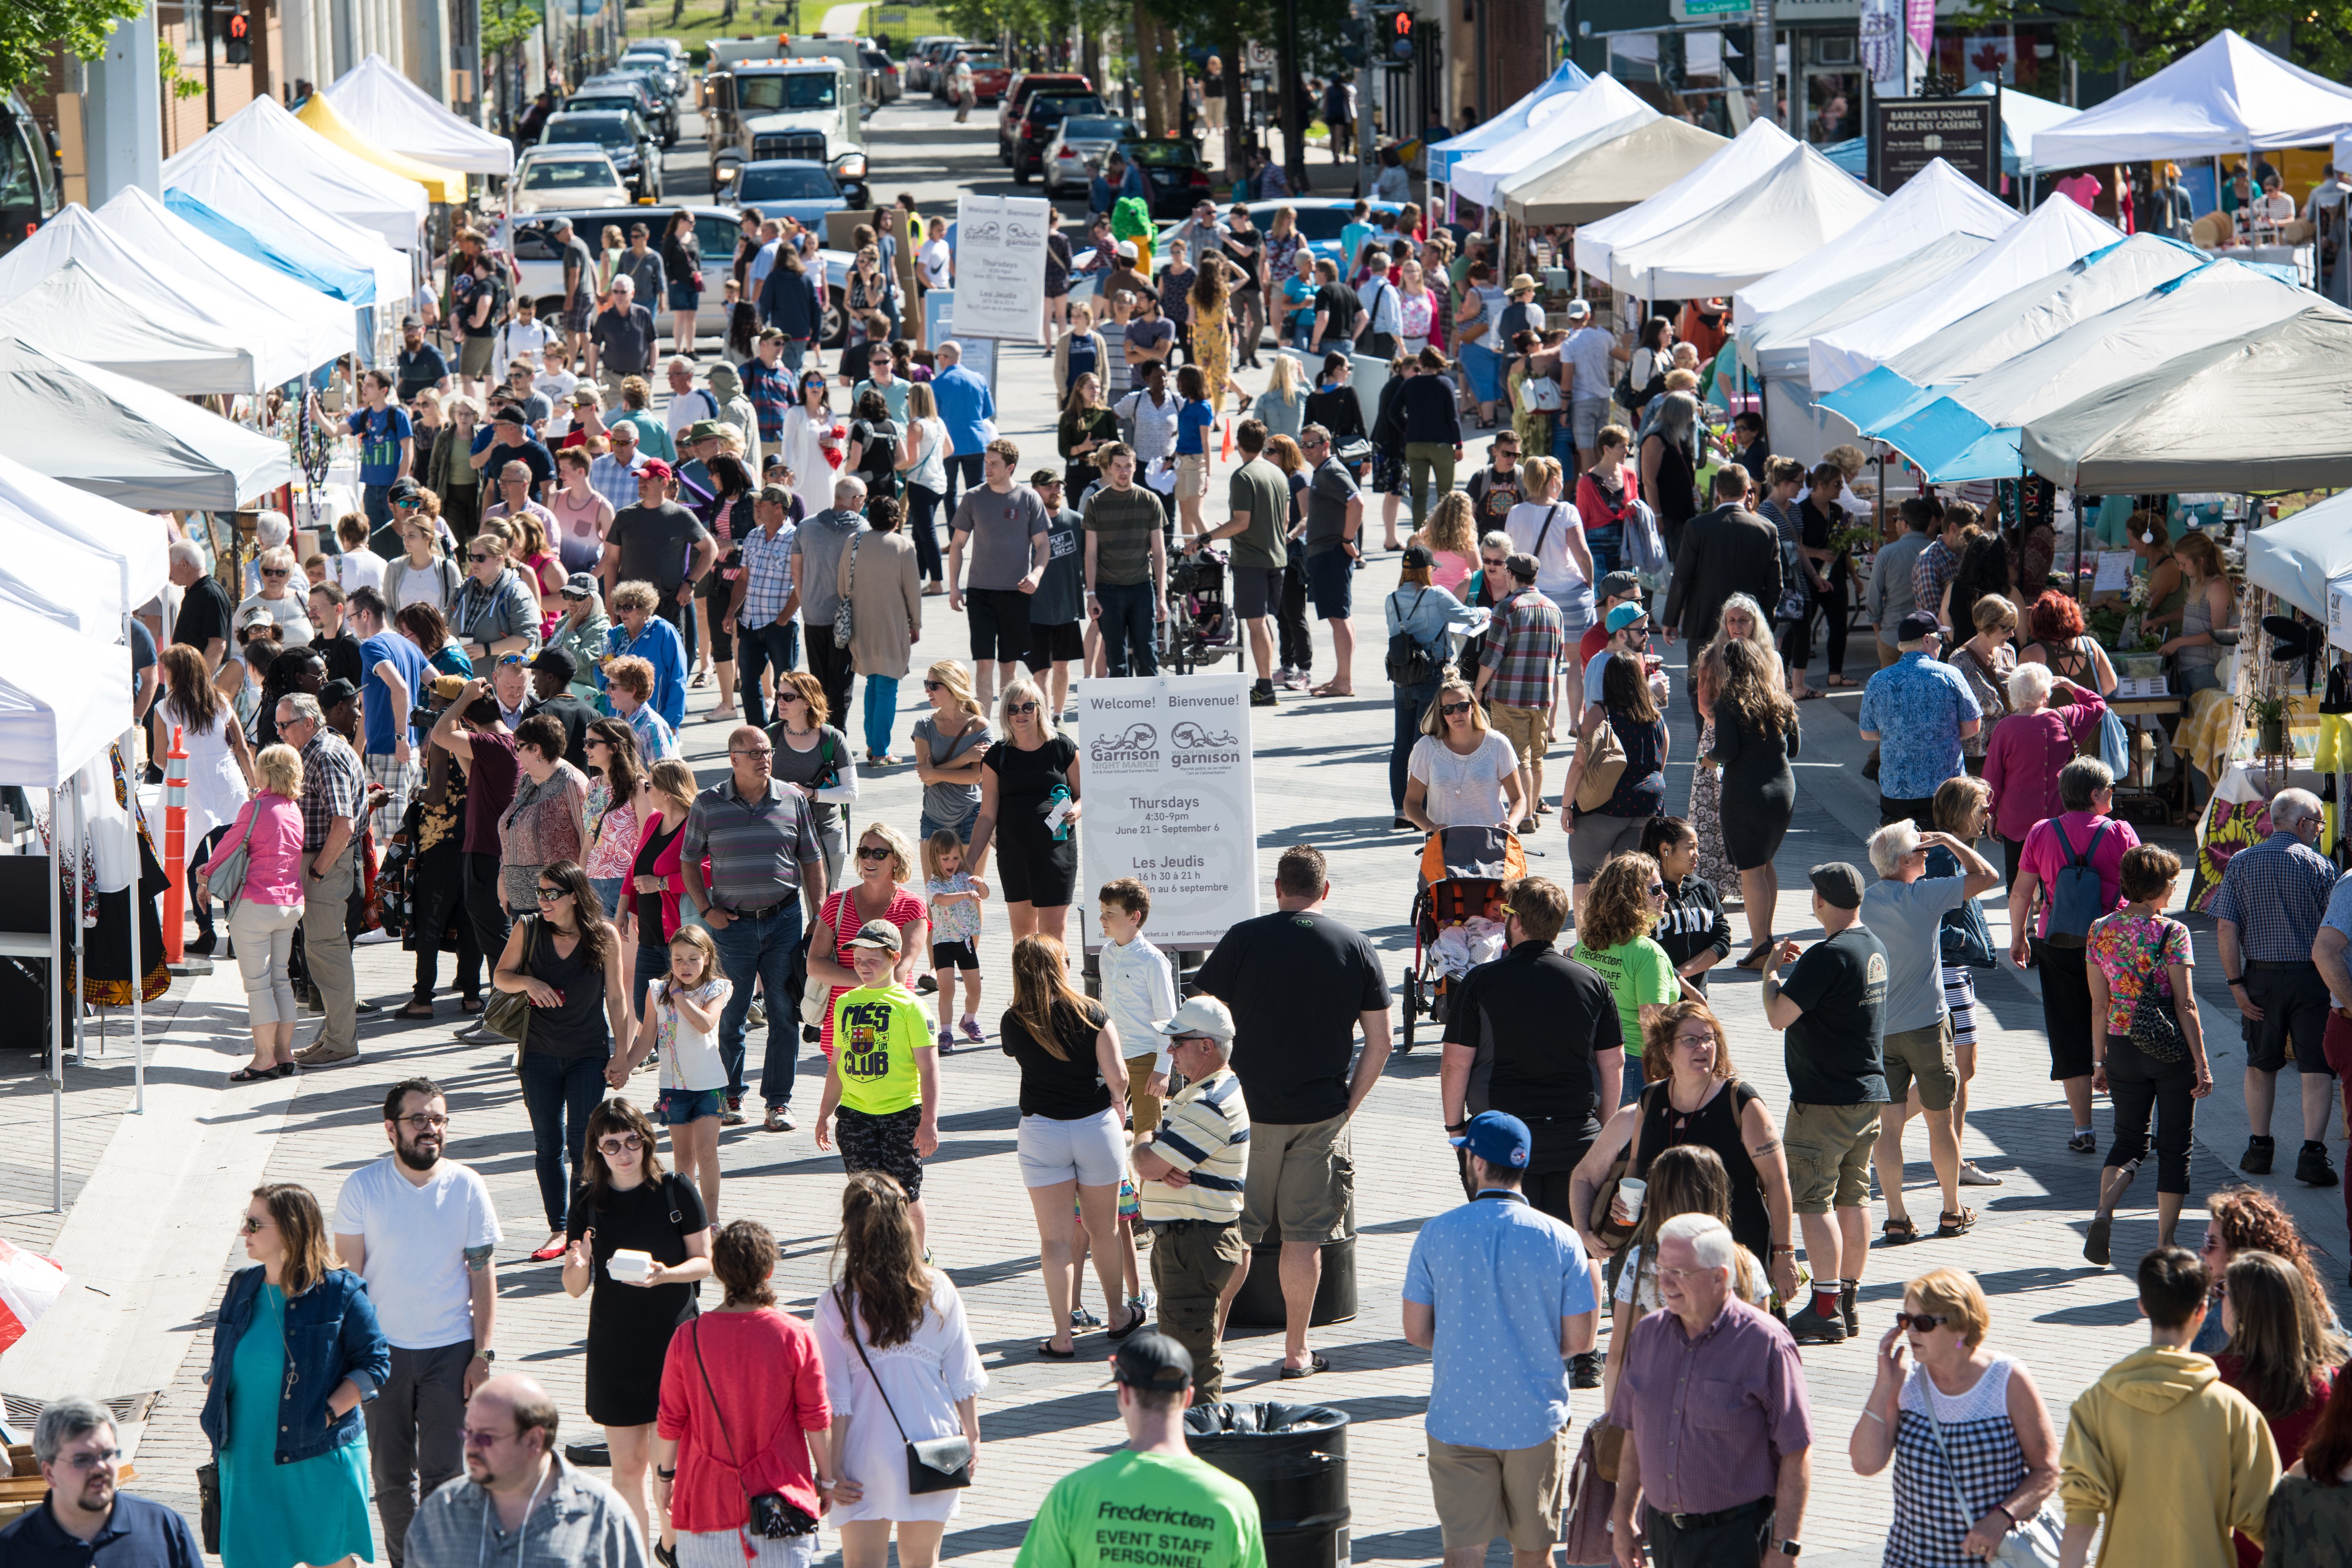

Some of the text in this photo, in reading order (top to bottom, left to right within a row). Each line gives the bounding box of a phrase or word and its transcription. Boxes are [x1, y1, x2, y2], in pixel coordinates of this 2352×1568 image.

[1891, 109, 1978, 121] BARRACKS SQUARE
[1887, 120, 1983, 131] PLACE DES CASERNES
[964, 232, 1000, 241] Garrison
[982, 259, 1018, 268] Thursdays
[1050, 534, 1064, 544] PLAY
[2331, 593, 2342, 610] QUIK
[1090, 696, 1156, 710] Welcome!
[1169, 694, 1239, 707] Bienvenue!
[1091, 749, 1159, 762] Garrison
[1171, 751, 1240, 768] garnison
[1092, 760, 1159, 770] NIGHT MARKET
[1129, 796, 1200, 811] Thursdays
[1146, 812, 1189, 822] 4:30-9pm
[1115, 826, 1137, 835] June
[1162, 824, 1211, 835] September
[1133, 855, 1204, 868] Les Jeudis
[1173, 872, 1178, 880] à
[1179, 883, 1228, 894] septembre
[1656, 907, 1714, 941] PINK
[1579, 948, 1622, 966] Fredericton
[1599, 969, 1621, 980] STAFF
[841, 1002, 892, 1033] MÉS
[879, 1042, 888, 1051] UN
[844, 1050, 889, 1076] CLUB
[1098, 1501, 1215, 1532] Fredericton
[1096, 1529, 1213, 1555] EVENT STAFF
[1100, 1547, 1206, 1568] PERSONNEL
